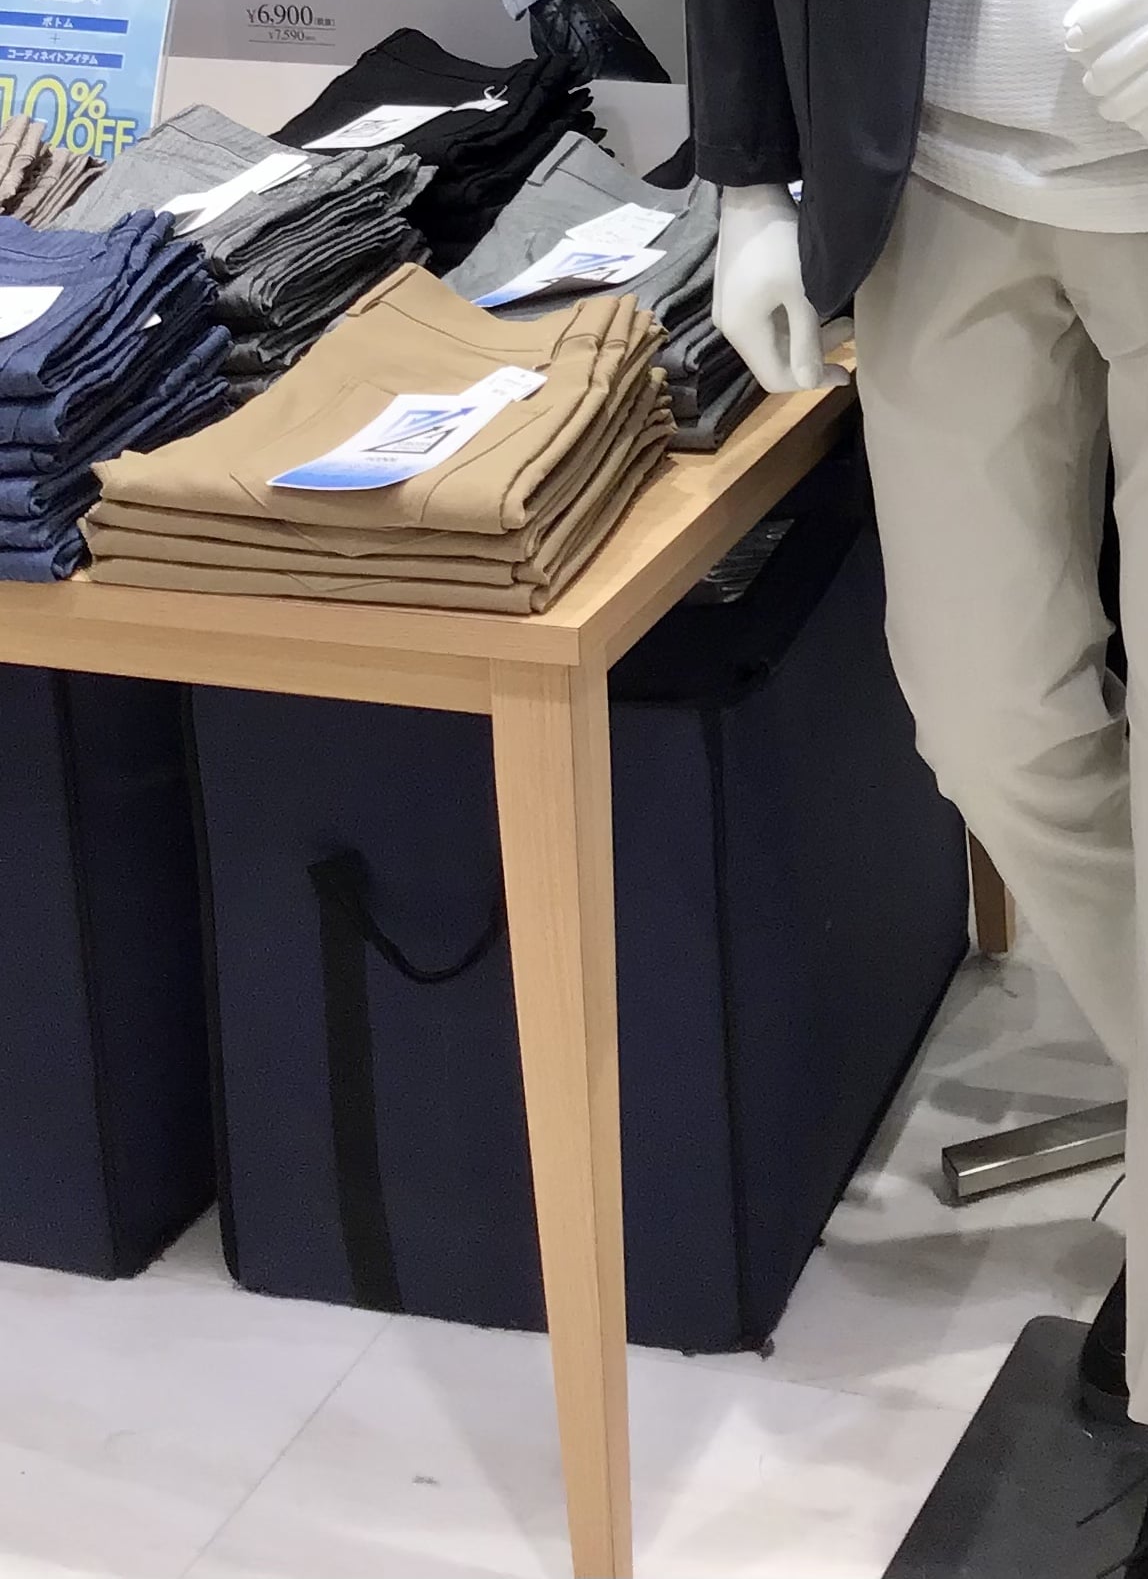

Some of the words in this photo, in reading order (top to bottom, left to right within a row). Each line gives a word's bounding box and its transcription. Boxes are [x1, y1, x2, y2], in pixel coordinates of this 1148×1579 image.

[42, 16, 73, 29] ボトム
[7, 48, 99, 65] コーディネイトアイテム
[66, 117, 136, 156] OFF
